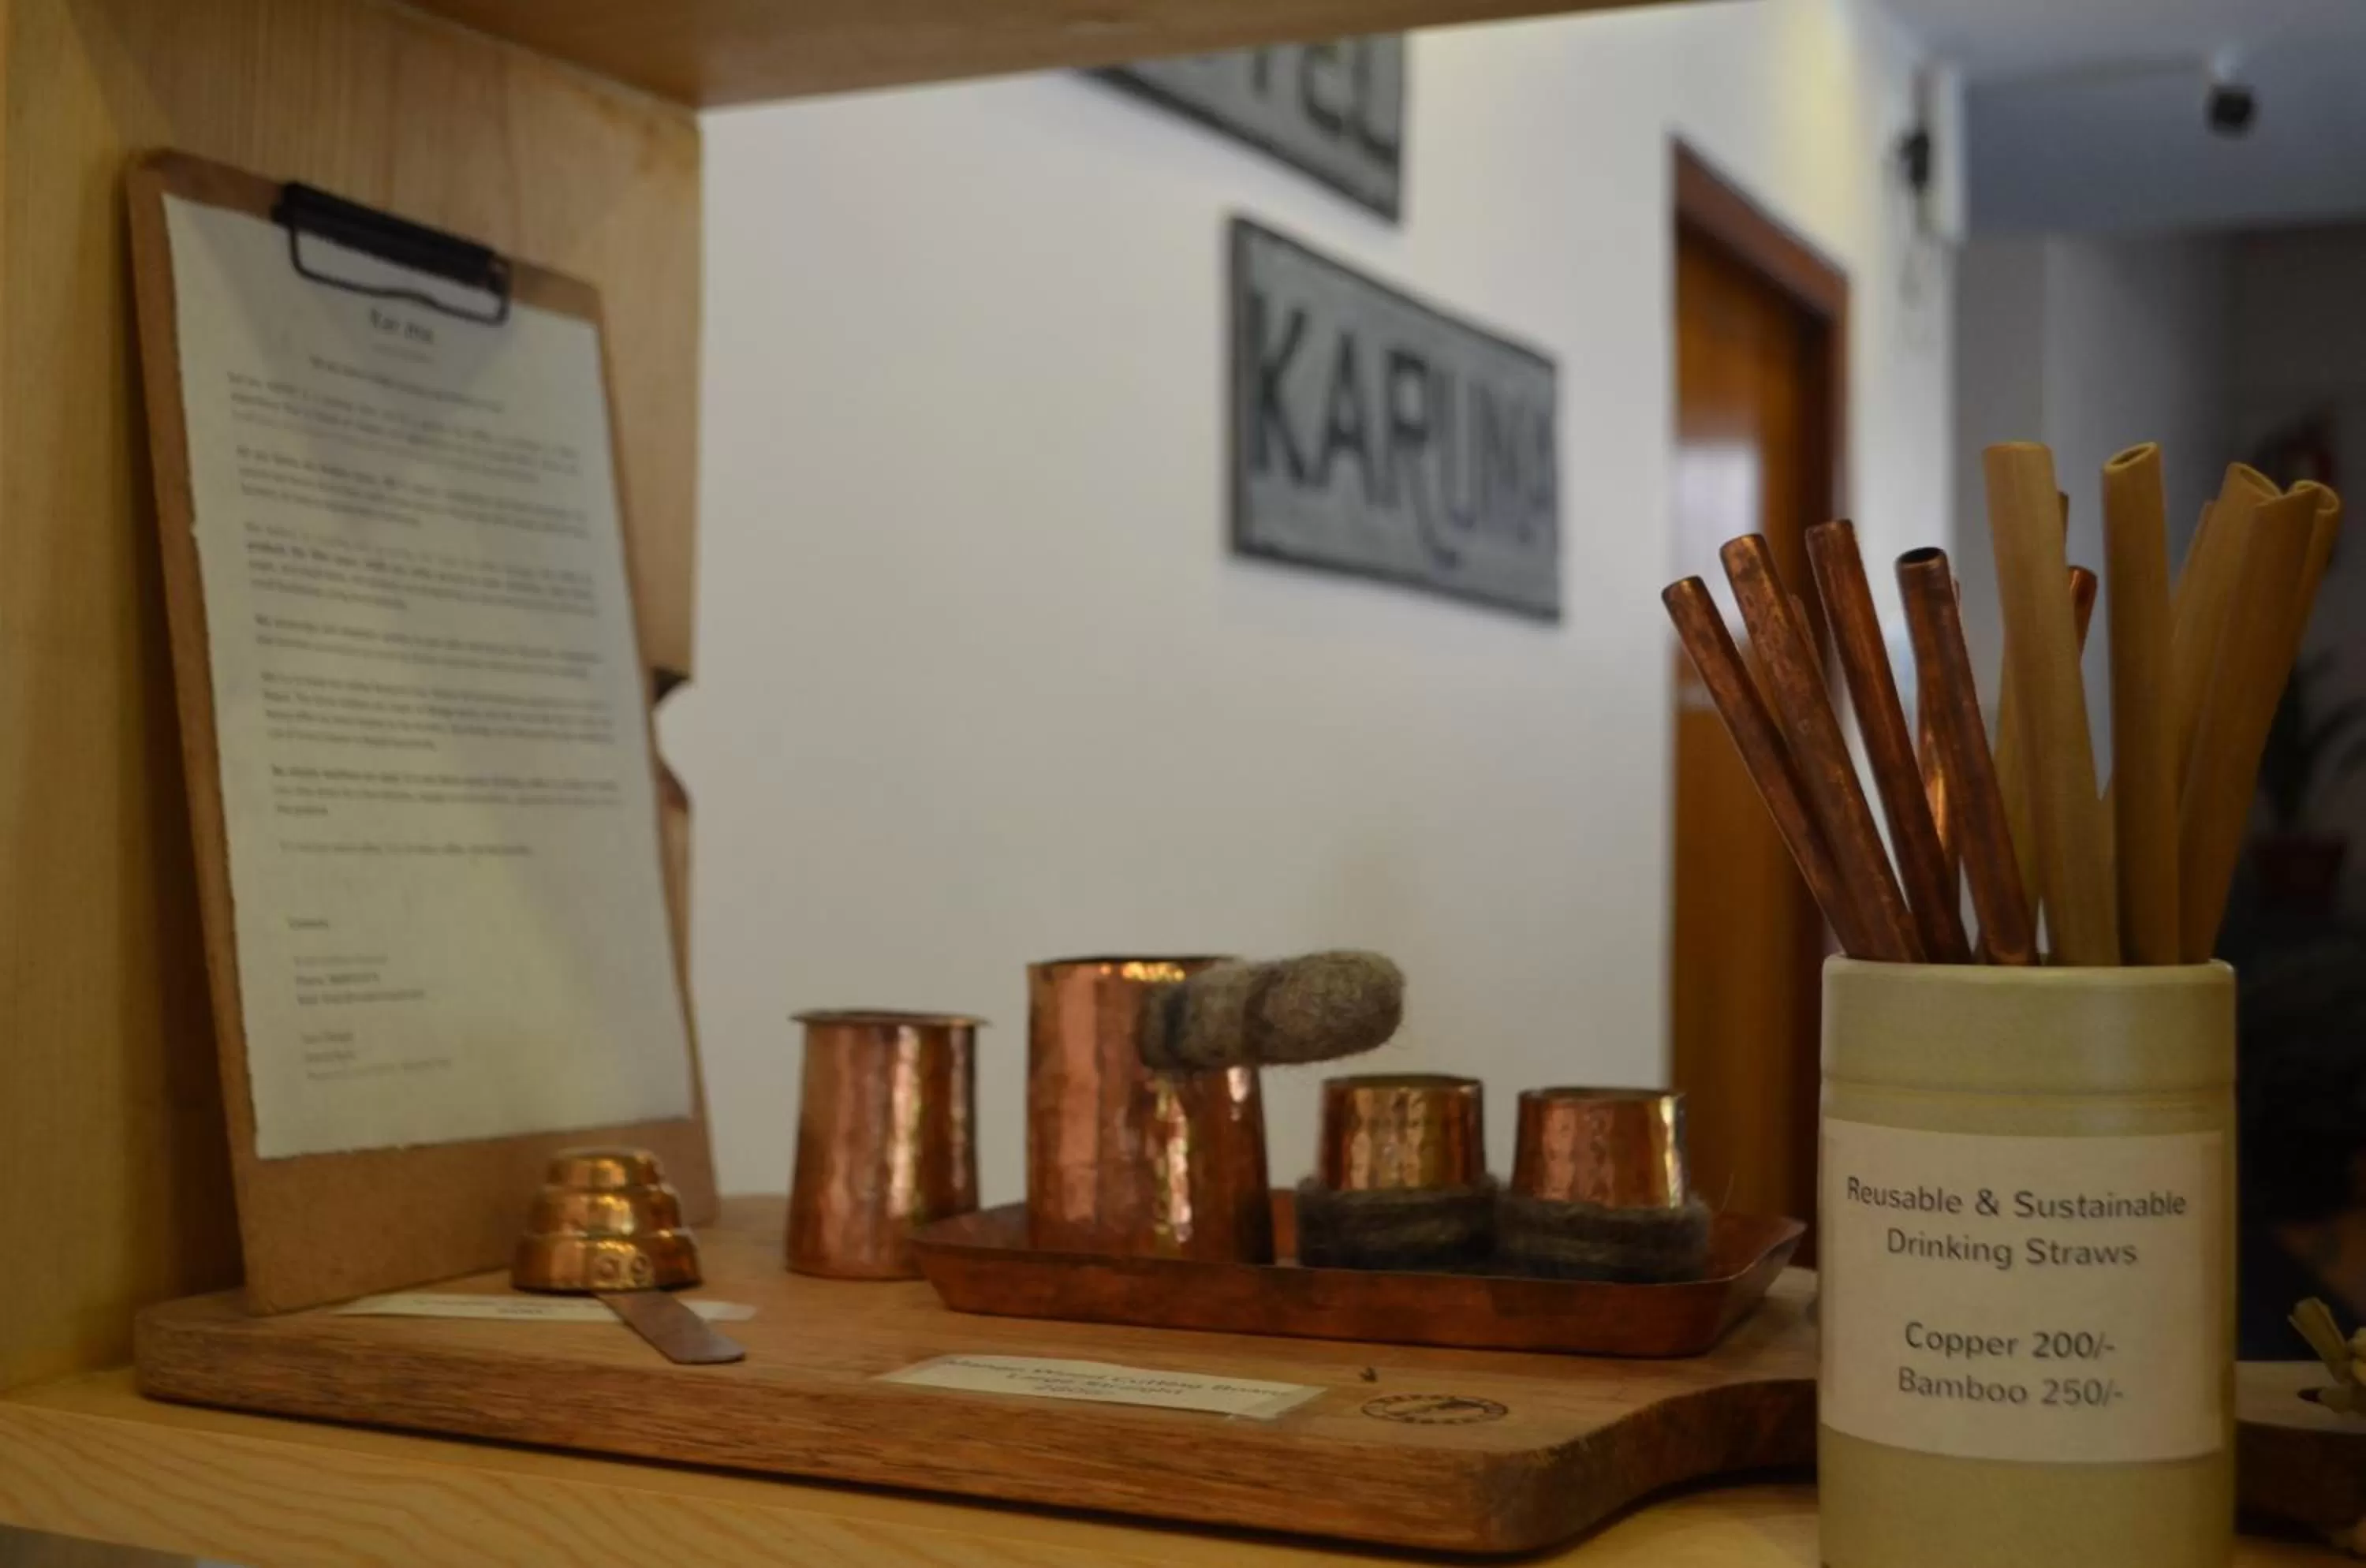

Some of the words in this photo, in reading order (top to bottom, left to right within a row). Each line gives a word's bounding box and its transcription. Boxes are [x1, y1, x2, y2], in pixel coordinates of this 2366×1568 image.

[1846, 1175, 1963, 1215] Reusable
[1974, 1188, 2000, 1218] &
[2013, 1191, 2188, 1219] Sustainable
[1886, 1228, 2013, 1271] Drinking
[2025, 1238, 2138, 1267] Straws
[1905, 1321, 2019, 1360] Copper
[2032, 1331, 2115, 1361] 200/-
[1898, 1366, 2028, 1405] Bamboo
[2040, 1379, 2124, 1408] 250/-
